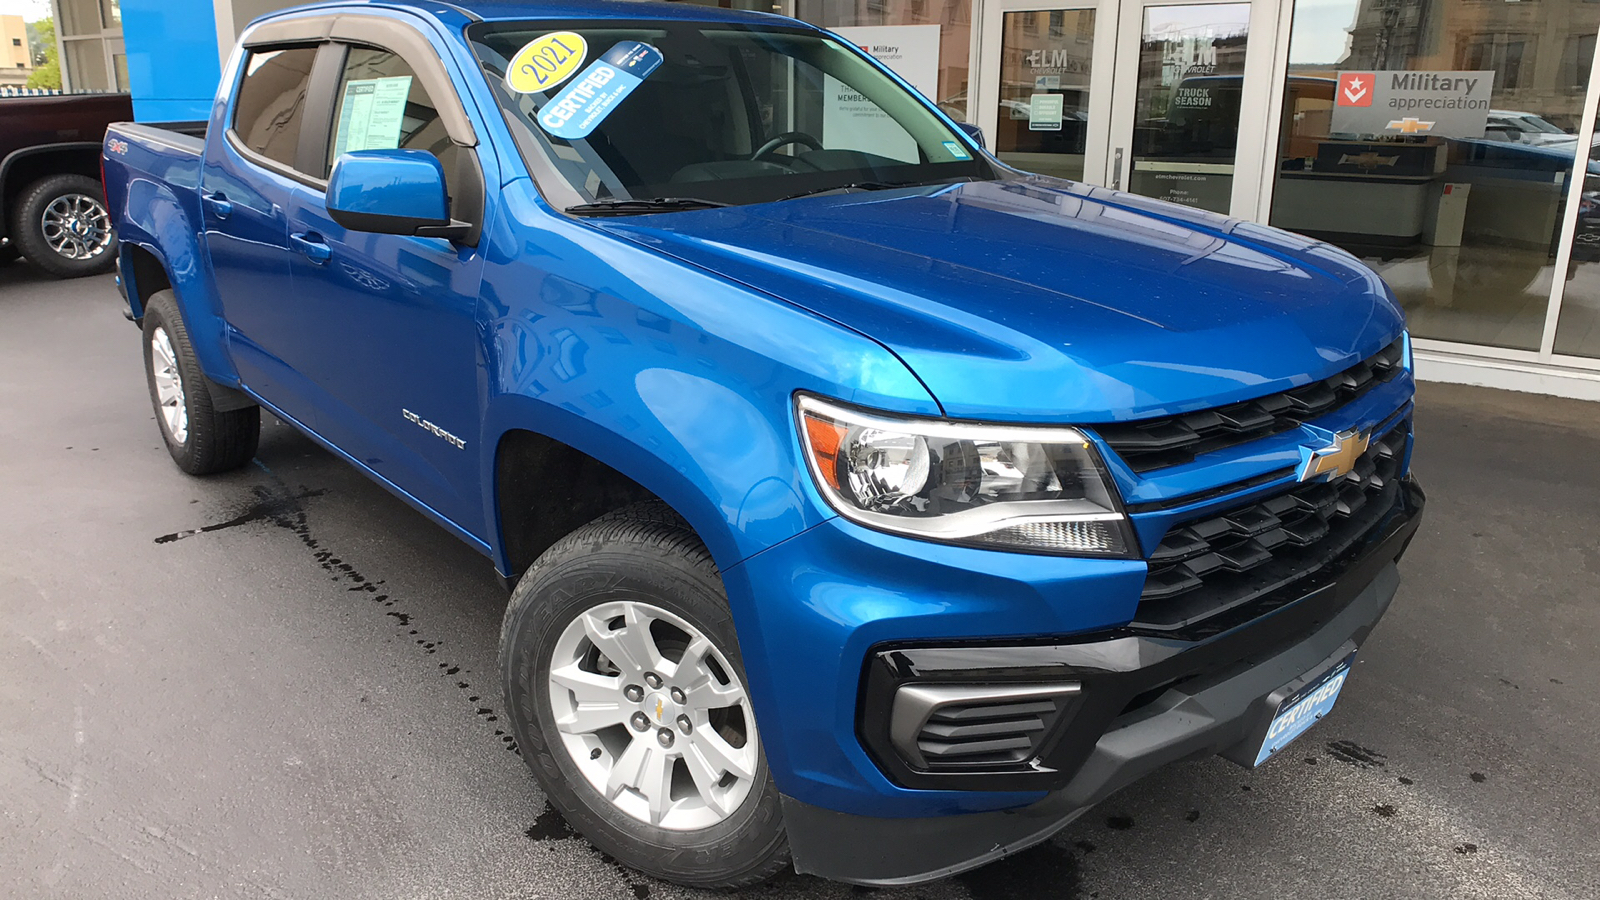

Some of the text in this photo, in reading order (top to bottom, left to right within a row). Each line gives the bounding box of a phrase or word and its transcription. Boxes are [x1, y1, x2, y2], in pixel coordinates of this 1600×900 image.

[873, 45, 899, 53] Military
[1027, 49, 1067, 68] ELM
[521, 38, 576, 85] 2021
[1179, 88, 1209, 97] TRUCK
[1391, 73, 1478, 95] Military
[542, 66, 616, 129] CERTIFIED
[1175, 97, 1212, 106] SEASON
[1388, 96, 1488, 110] appreciation
[402, 408, 467, 450] COLORADO
[1269, 675, 1344, 740] CERTIFIED
